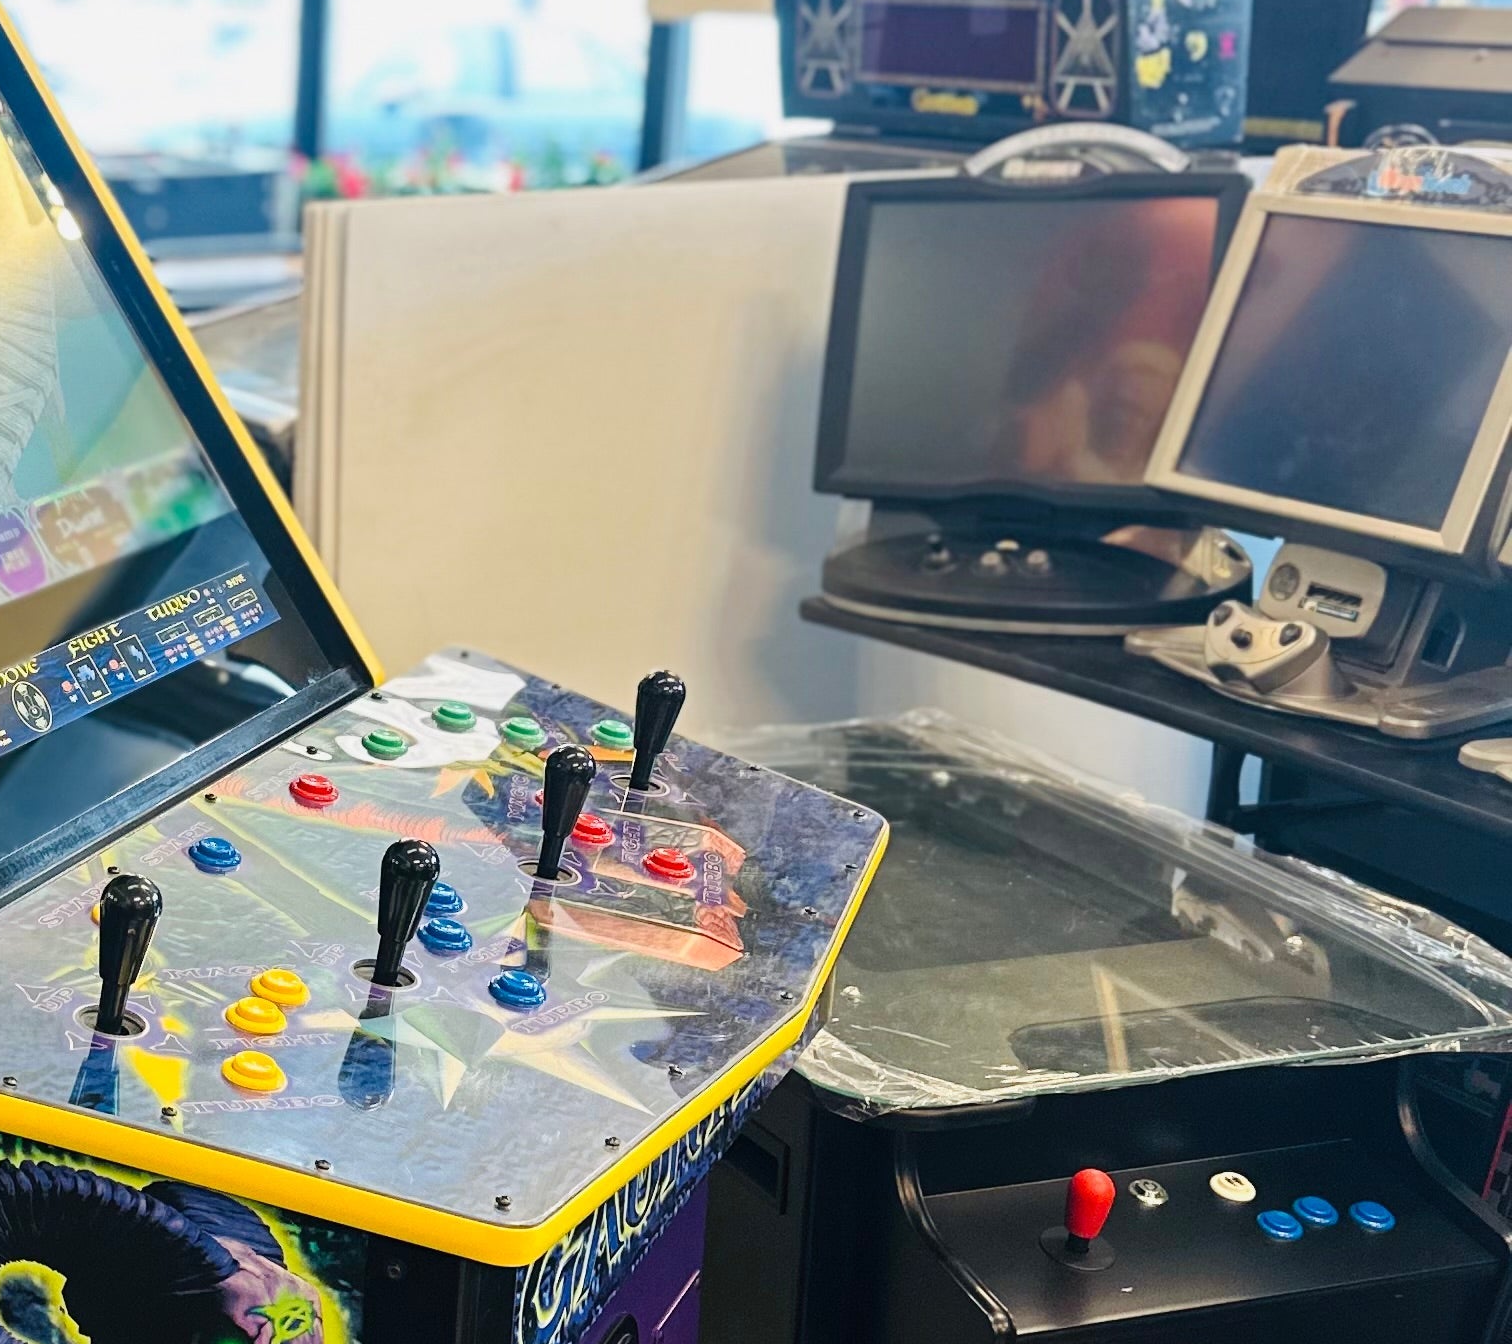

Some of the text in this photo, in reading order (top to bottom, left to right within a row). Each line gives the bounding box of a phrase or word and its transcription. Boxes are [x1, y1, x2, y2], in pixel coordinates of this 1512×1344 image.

[144, 588, 202, 623] TURBO
[67, 622, 124, 659] FIGHT
[139, 820, 216, 867] START
[510, 990, 611, 1034] TURBO
[208, 1032, 337, 1051] FIGHT
[176, 1094, 346, 1116] TURBO
